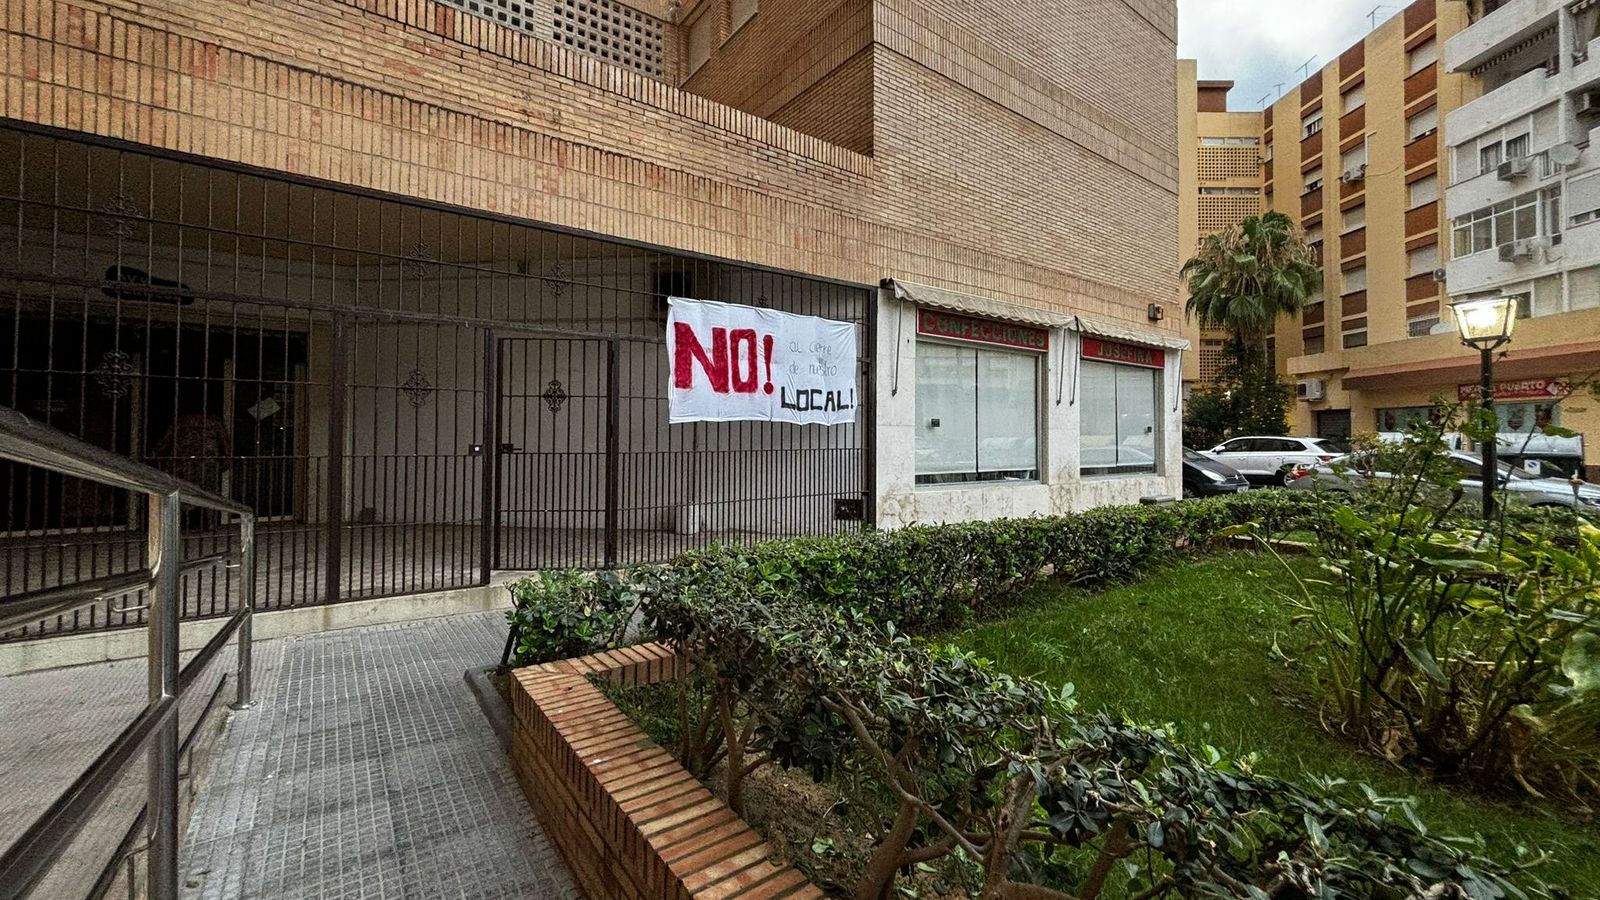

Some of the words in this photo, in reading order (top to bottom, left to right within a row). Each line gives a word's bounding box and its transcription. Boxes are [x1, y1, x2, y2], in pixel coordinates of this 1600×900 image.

[923, 312, 1046, 347] CONFECCIONES
[674, 322, 774, 394] NO!
[789, 361, 800, 375] de
[780, 386, 855, 412] LOCAL!
[1500, 380, 1545, 392] PUERTO
